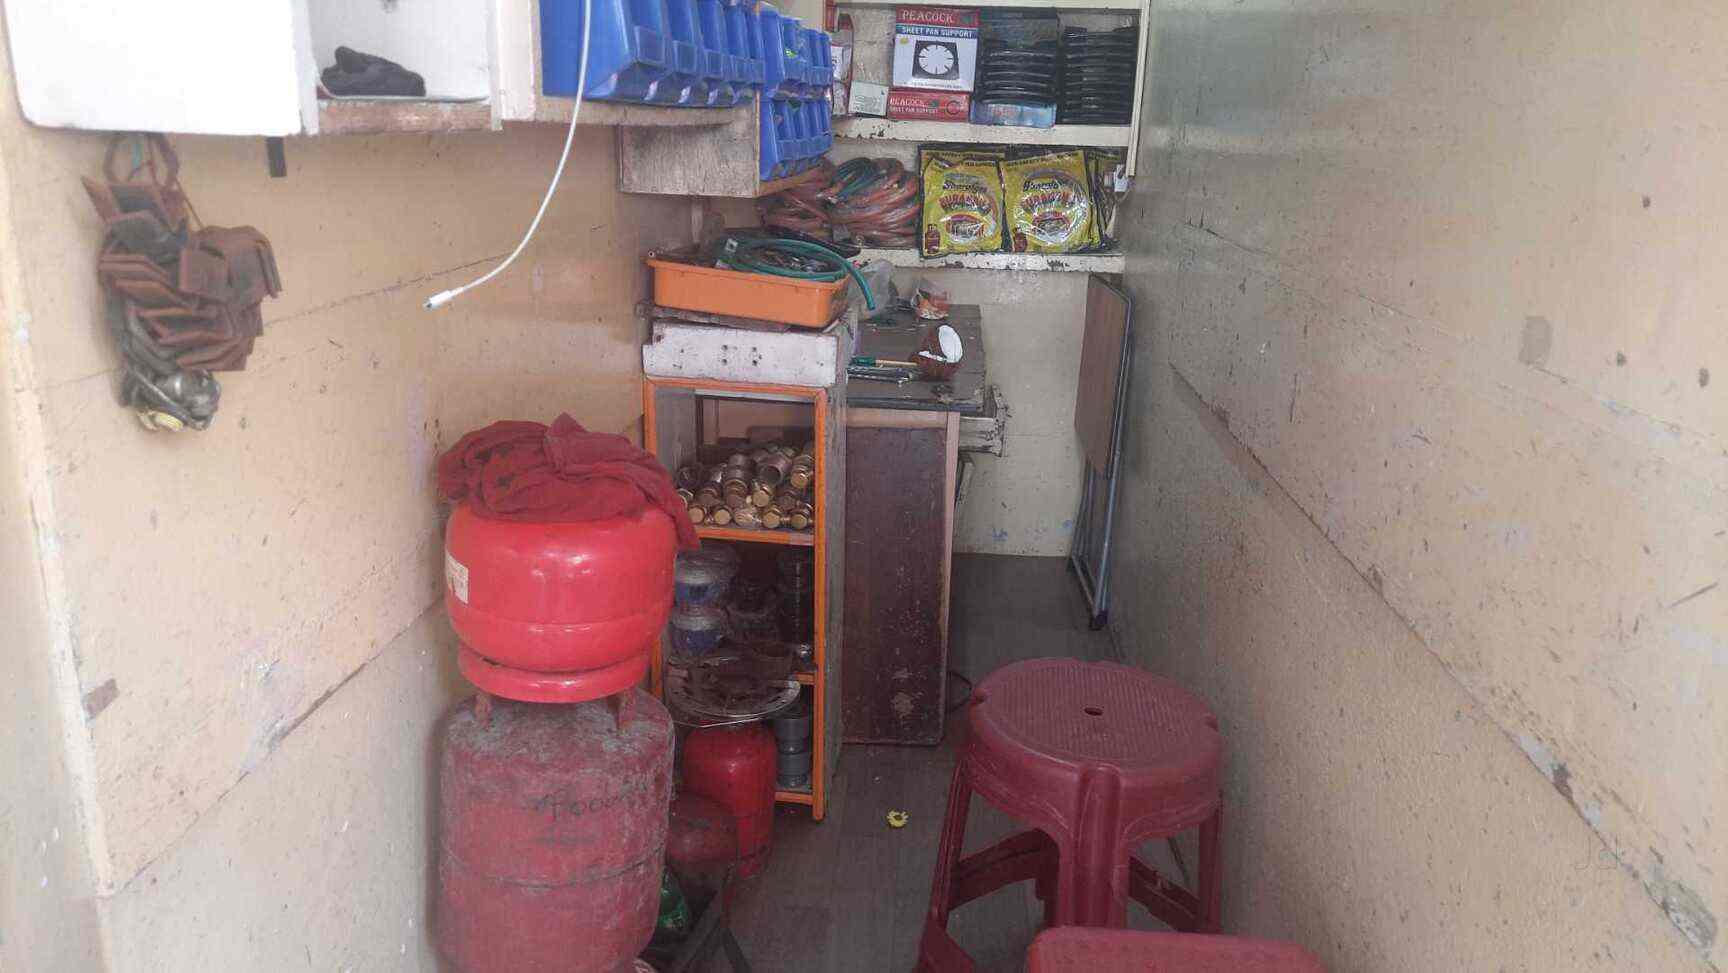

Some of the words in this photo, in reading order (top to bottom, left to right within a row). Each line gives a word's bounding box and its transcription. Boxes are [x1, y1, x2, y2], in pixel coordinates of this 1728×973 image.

[902, 9, 955, 24] PEACOCK
[902, 26, 923, 35] SHEET
[926, 28, 939, 36] PAN
[942, 29, 973, 39] SUPPORT
